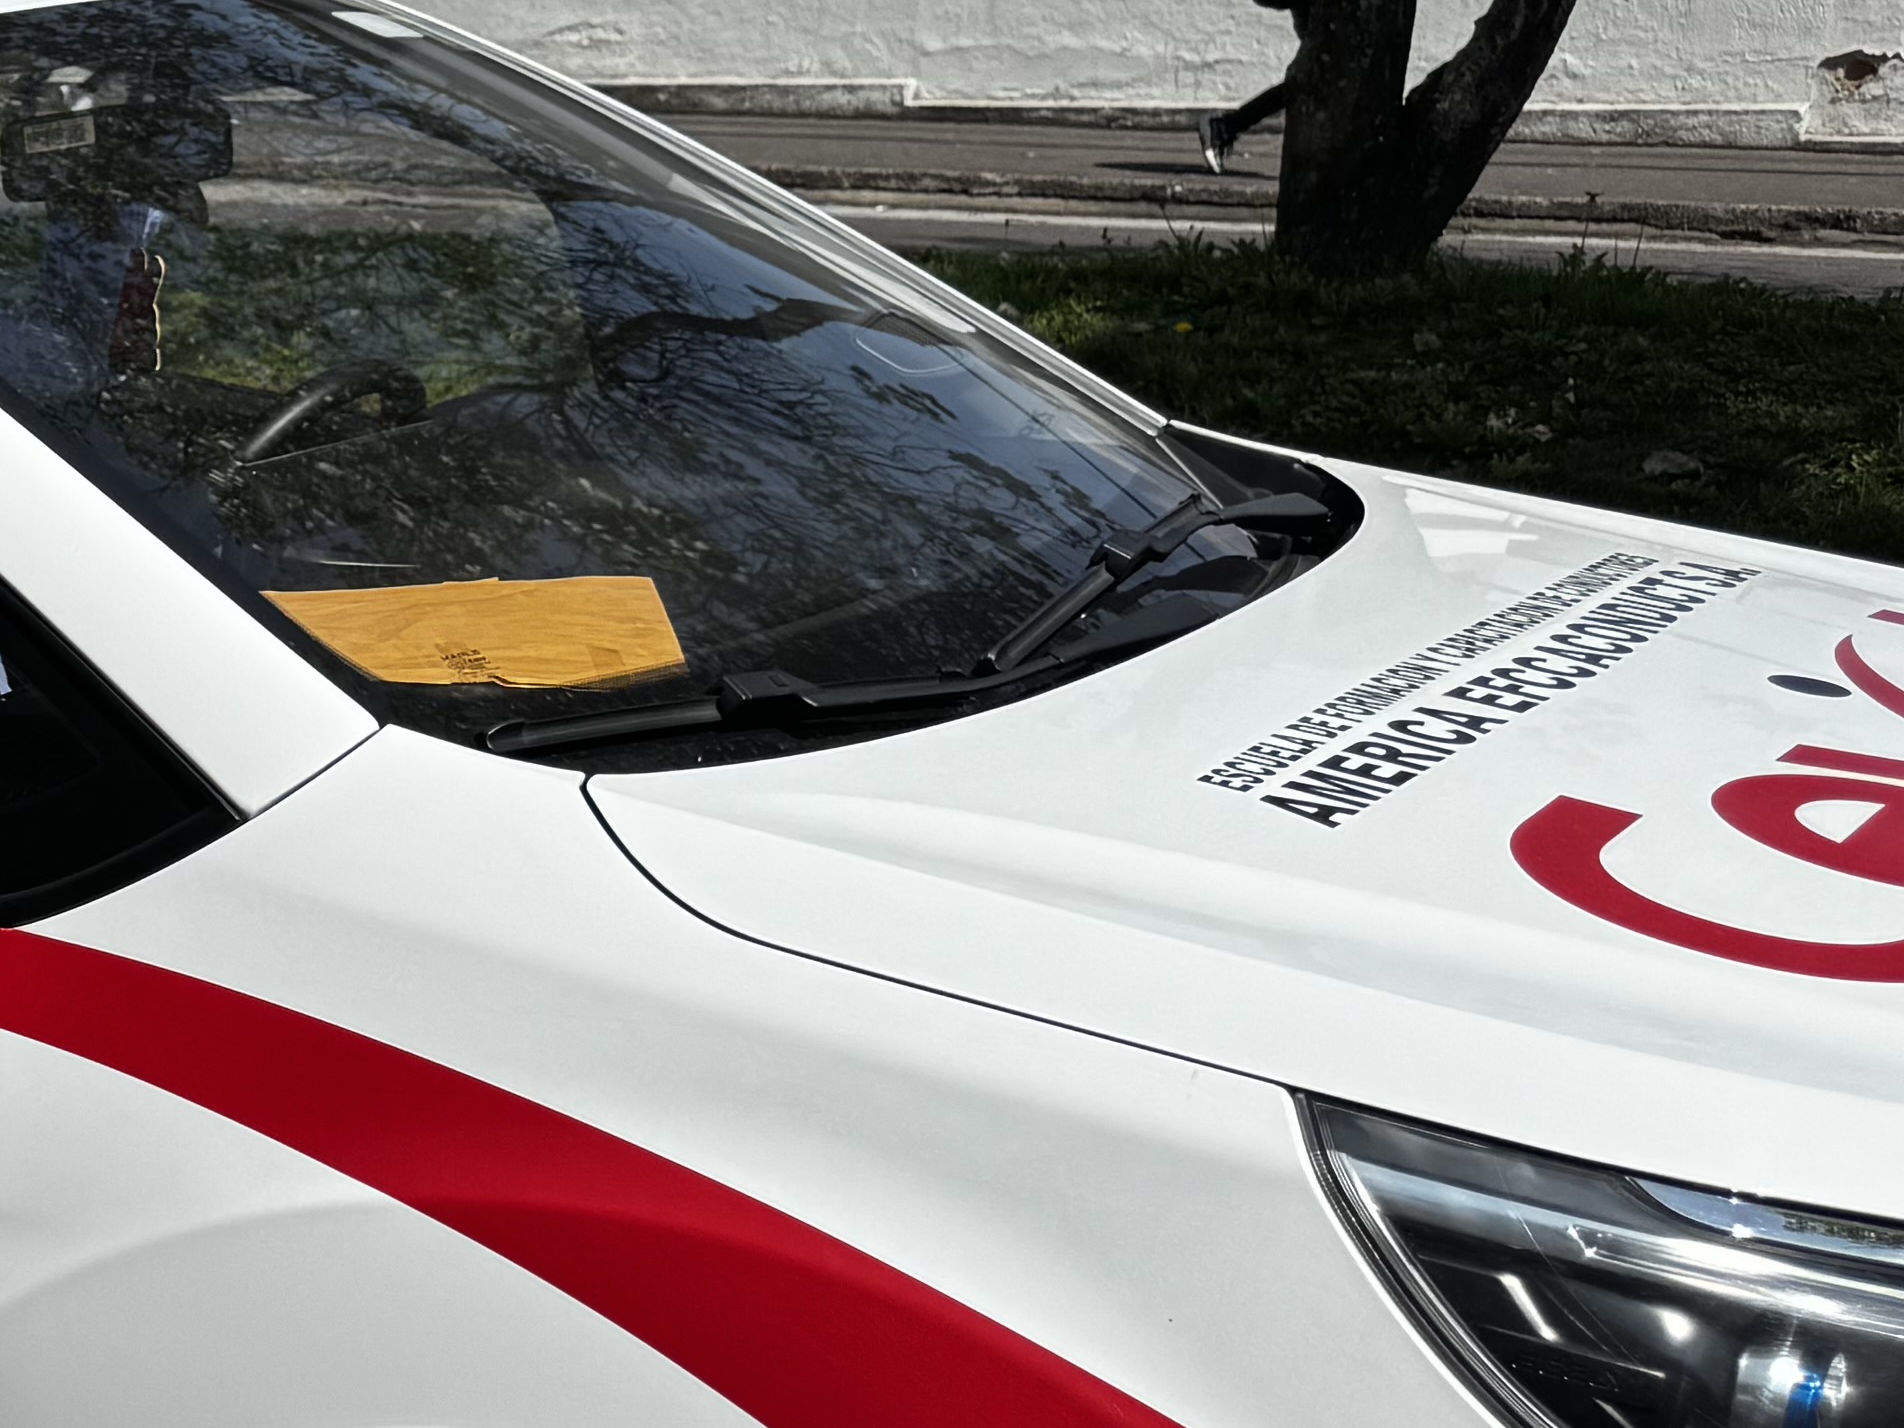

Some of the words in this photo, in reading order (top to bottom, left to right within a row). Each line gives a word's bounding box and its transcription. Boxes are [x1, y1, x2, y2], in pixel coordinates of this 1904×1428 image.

[1196, 733, 1327, 793] ESCUELA
[1284, 708, 1354, 740] DE
[1323, 662, 1449, 723] FORMACION
[1426, 600, 1565, 658] CAPACITACION
[1259, 706, 1509, 829] AMERICA
